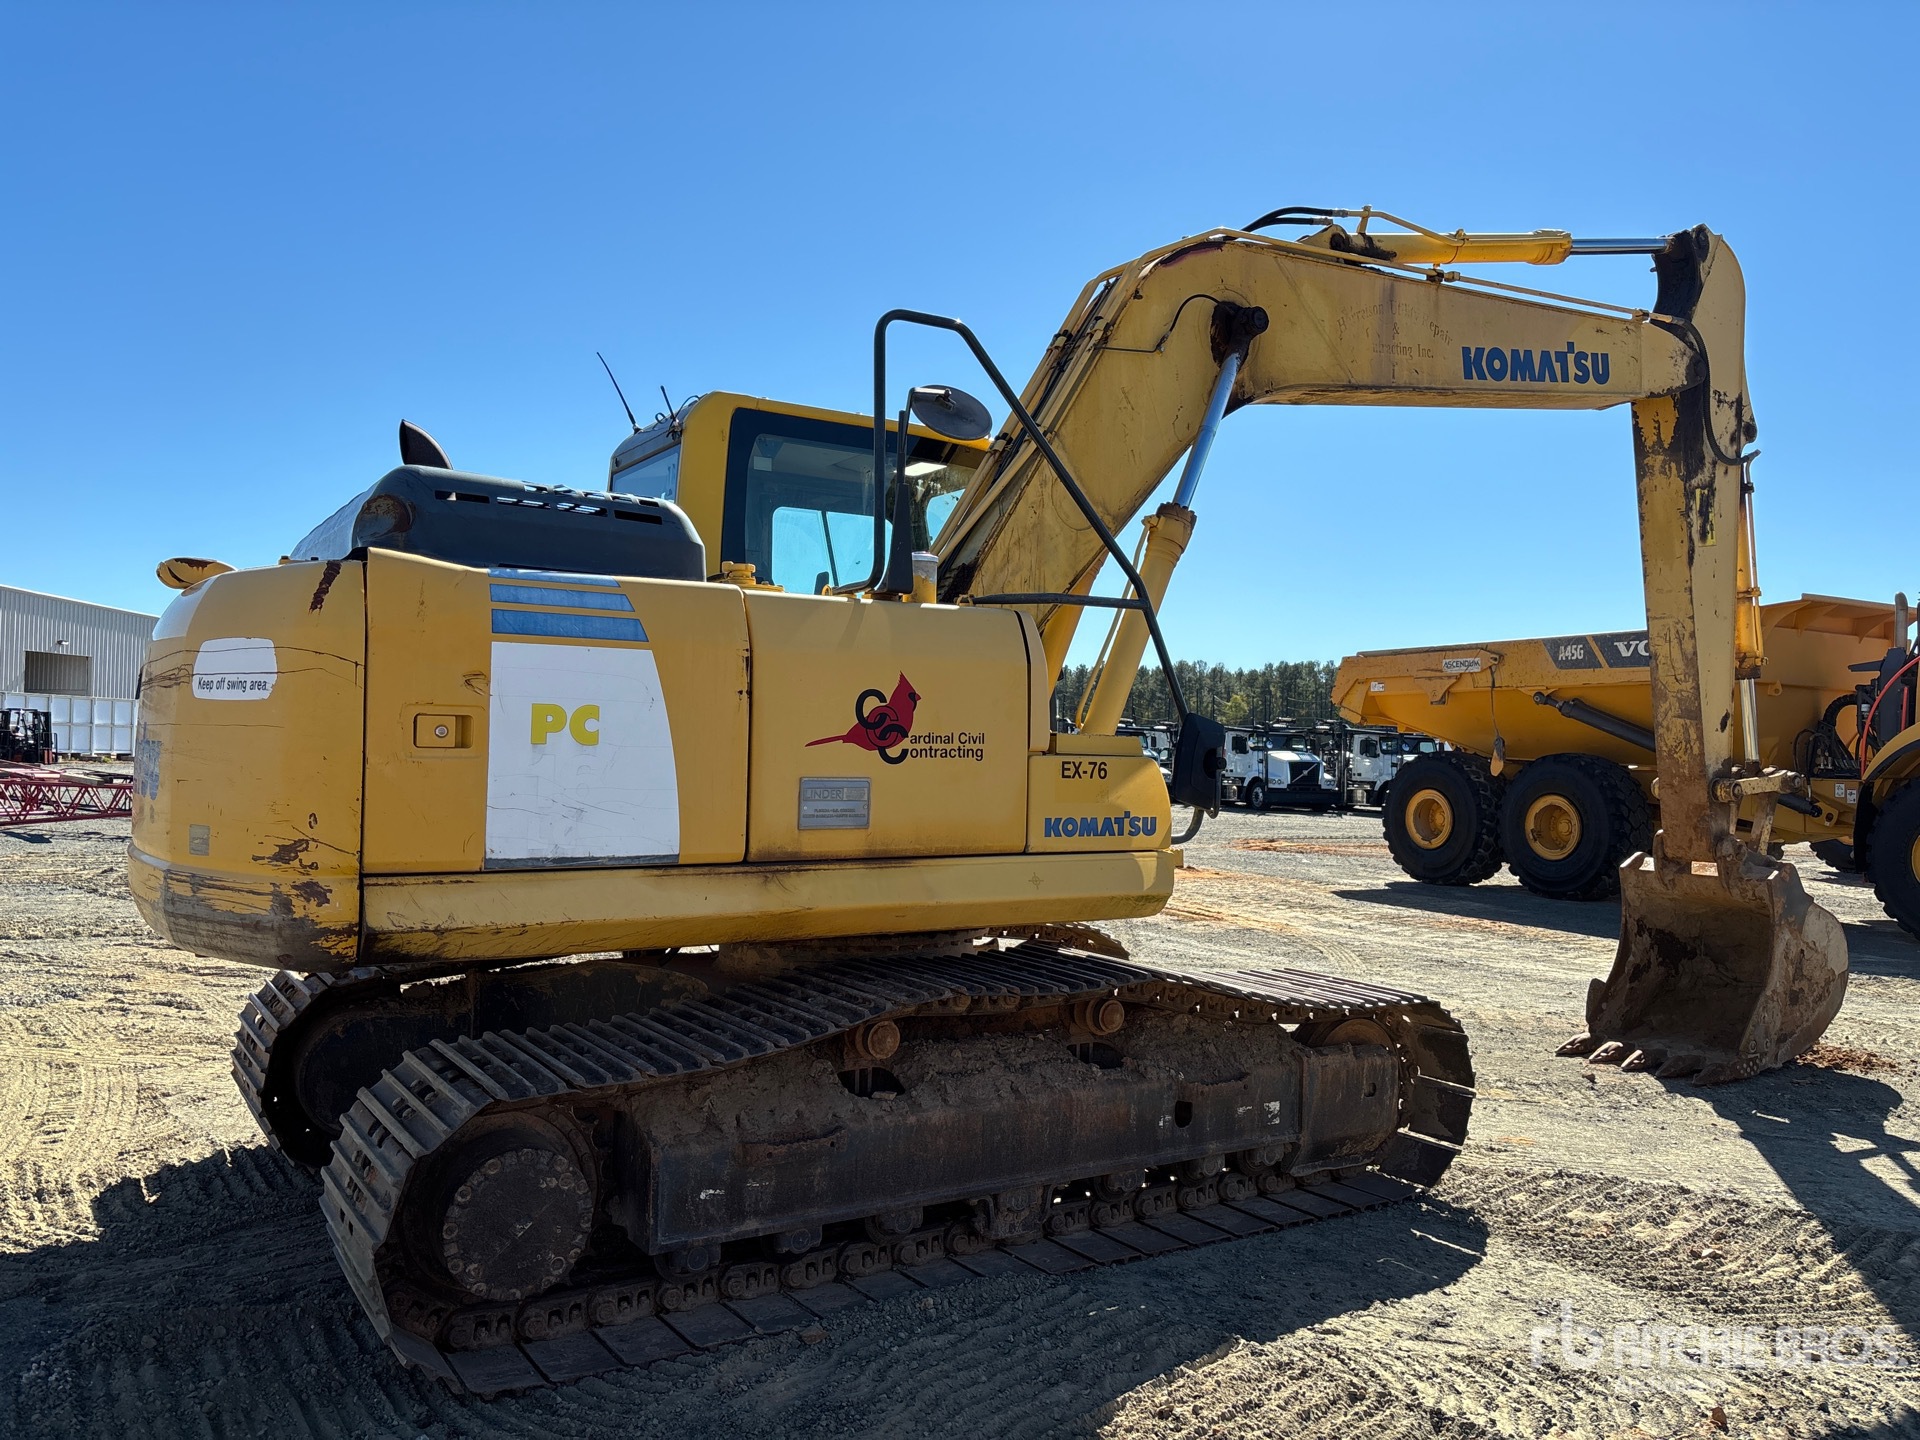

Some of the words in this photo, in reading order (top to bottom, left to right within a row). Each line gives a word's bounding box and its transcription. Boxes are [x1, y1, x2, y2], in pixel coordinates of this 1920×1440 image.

[1417, 343, 1434, 359] Inc.
[1461, 341, 1610, 385] KOMATSU
[1558, 644, 1584, 660] A45G
[197, 676, 214, 692] Keep
[215, 677, 226, 691] off
[226, 677, 247, 693] swing
[249, 680, 267, 691] area
[530, 702, 600, 747] PC
[957, 732, 985, 745] Civil
[1061, 760, 1108, 780] EX-76
[805, 789, 842, 800] LINDER
[1044, 810, 1157, 838] KOMATSU
